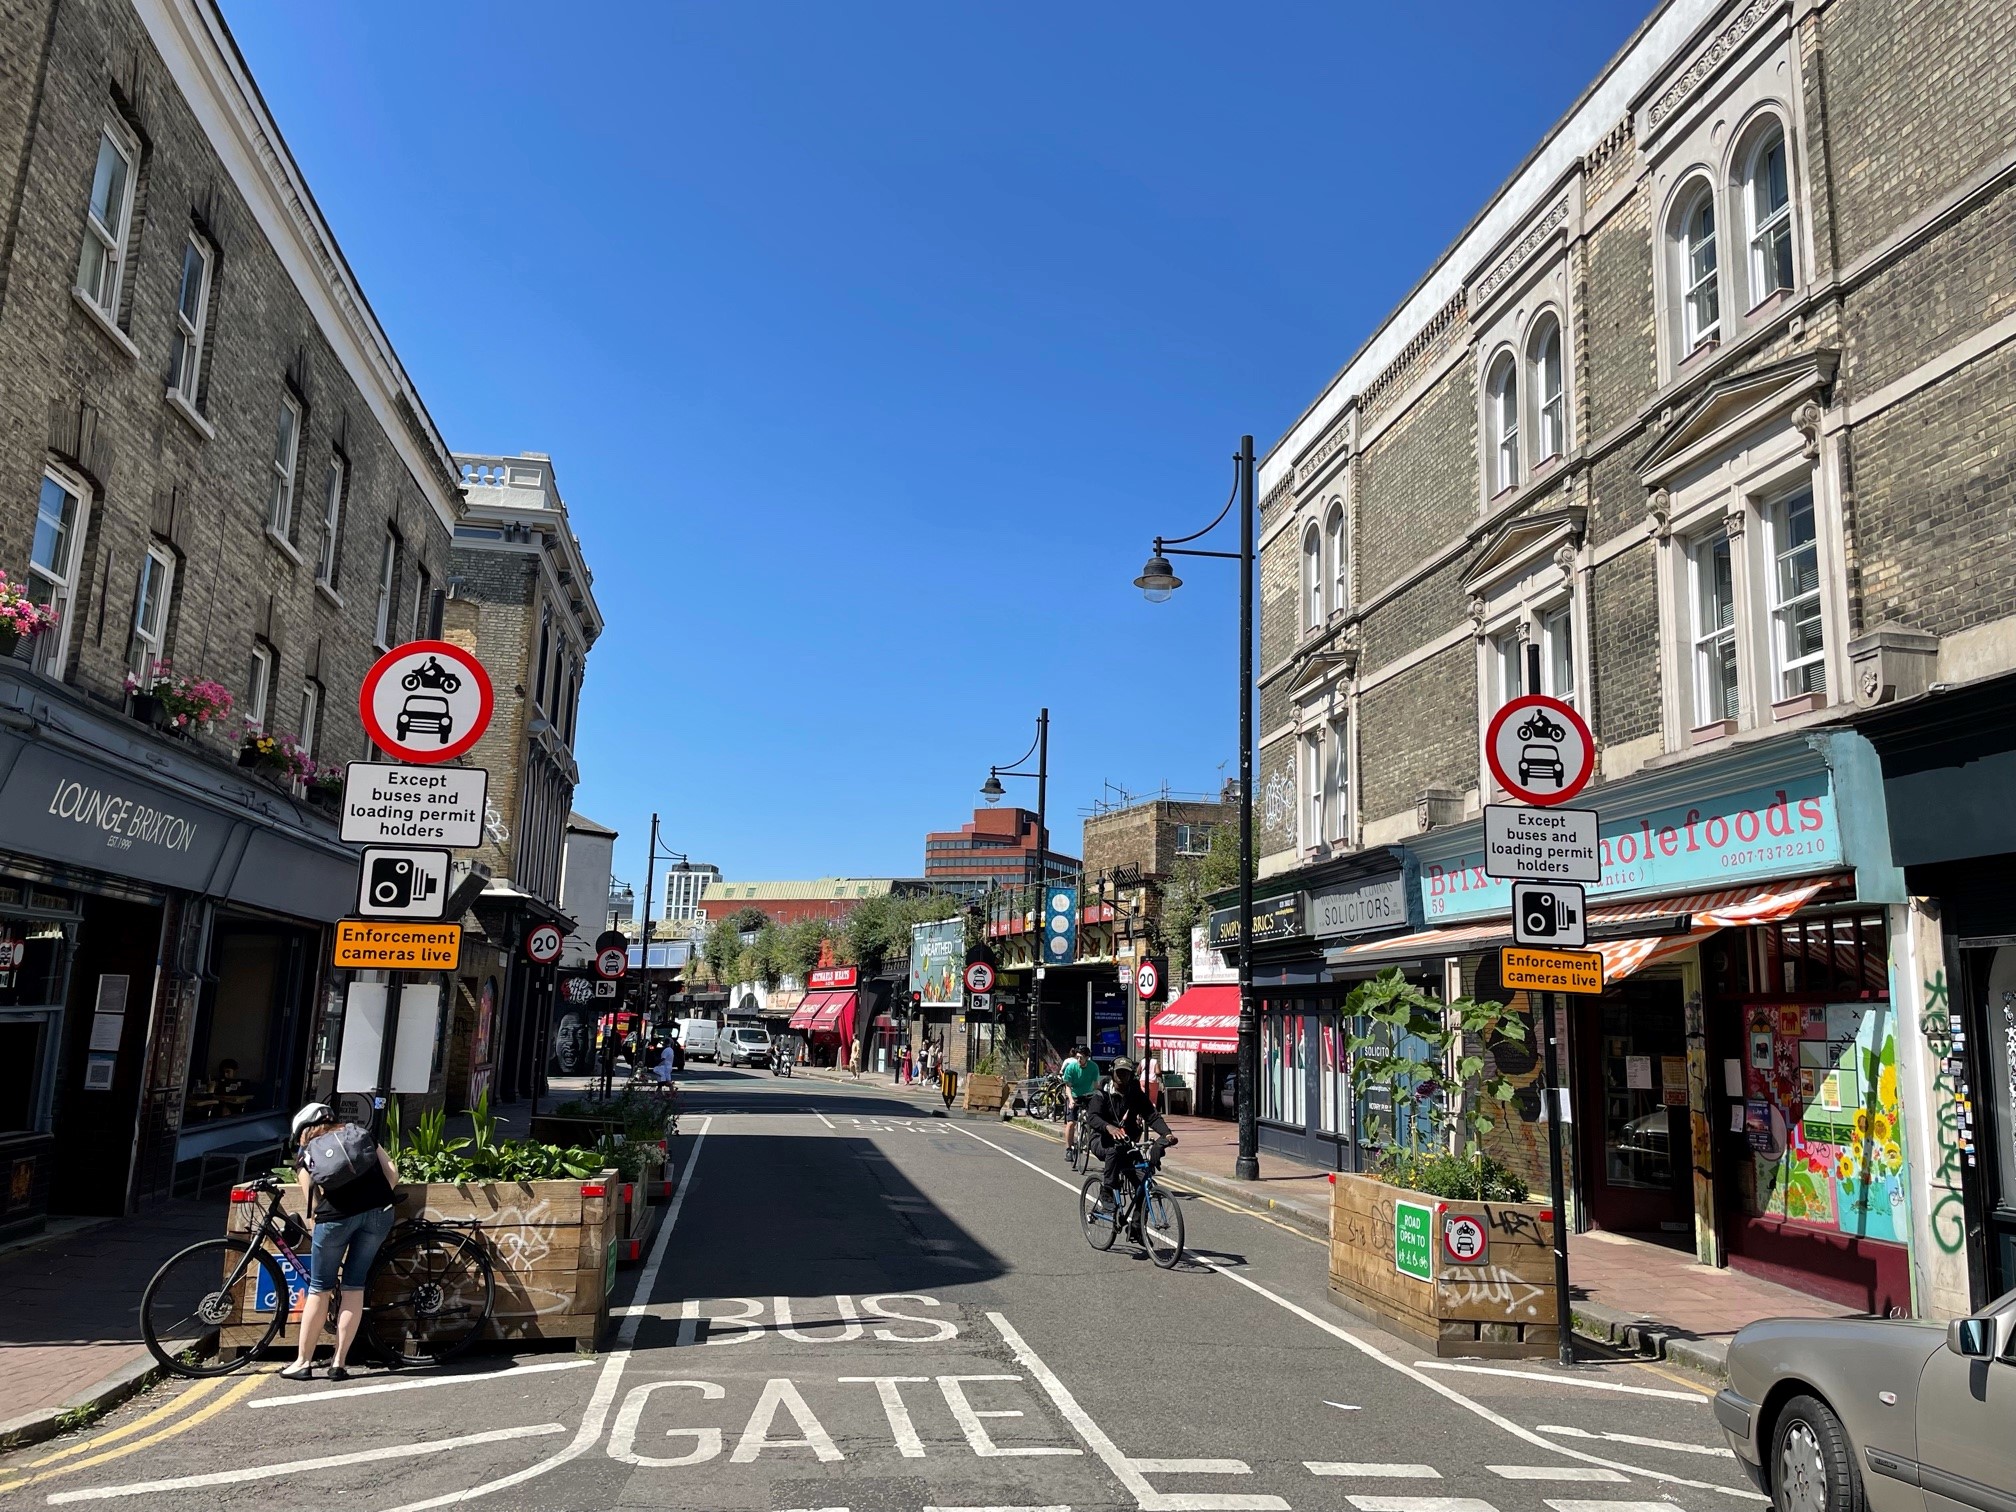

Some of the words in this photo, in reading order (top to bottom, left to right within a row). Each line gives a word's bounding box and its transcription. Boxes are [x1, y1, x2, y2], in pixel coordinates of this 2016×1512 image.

[388, 772, 447, 789] Except
[372, 788, 421, 803] buses
[427, 792, 459, 805] and
[48, 778, 134, 833] LOUNGE
[127, 805, 198, 853] BRIXTON
[350, 804, 414, 821] loading
[420, 809, 476, 823] permit
[1518, 813, 1566, 829] Except
[379, 822, 444, 838] holders
[1507, 828, 1547, 842] buses
[1552, 831, 1577, 843] and
[1491, 842, 1543, 858] loading
[1547, 846, 1594, 860] permit
[1516, 859, 1570, 873] holders
[1324, 896, 1390, 926] SOLICITORS
[1431, 898, 1445, 914] 59
[1252, 913, 1274, 934] BRICS
[342, 928, 456, 945] Enforcement
[533, 934, 558, 953] 20
[341, 949, 416, 961] cameras
[421, 948, 452, 962] live
[920, 941, 953, 957] UNEARTHED
[1506, 953, 1599, 971] Enforcement
[1139, 973, 1154, 988] 20
[1508, 972, 1568, 985] cameras
[1572, 972, 1598, 987] live
[1154, 1013, 1200, 1027] ATLANTIC
[1192, 1015, 1220, 1028] MEAT
[1364, 1046, 1390, 1057] SOLICITO
[1404, 1214, 1421, 1230] ROAD
[1400, 1230, 1416, 1245] OPEN
[1416, 1236, 1426, 1248] TO
[676, 1294, 958, 1346] BUS
[606, 1377, 1084, 1467] GATE
